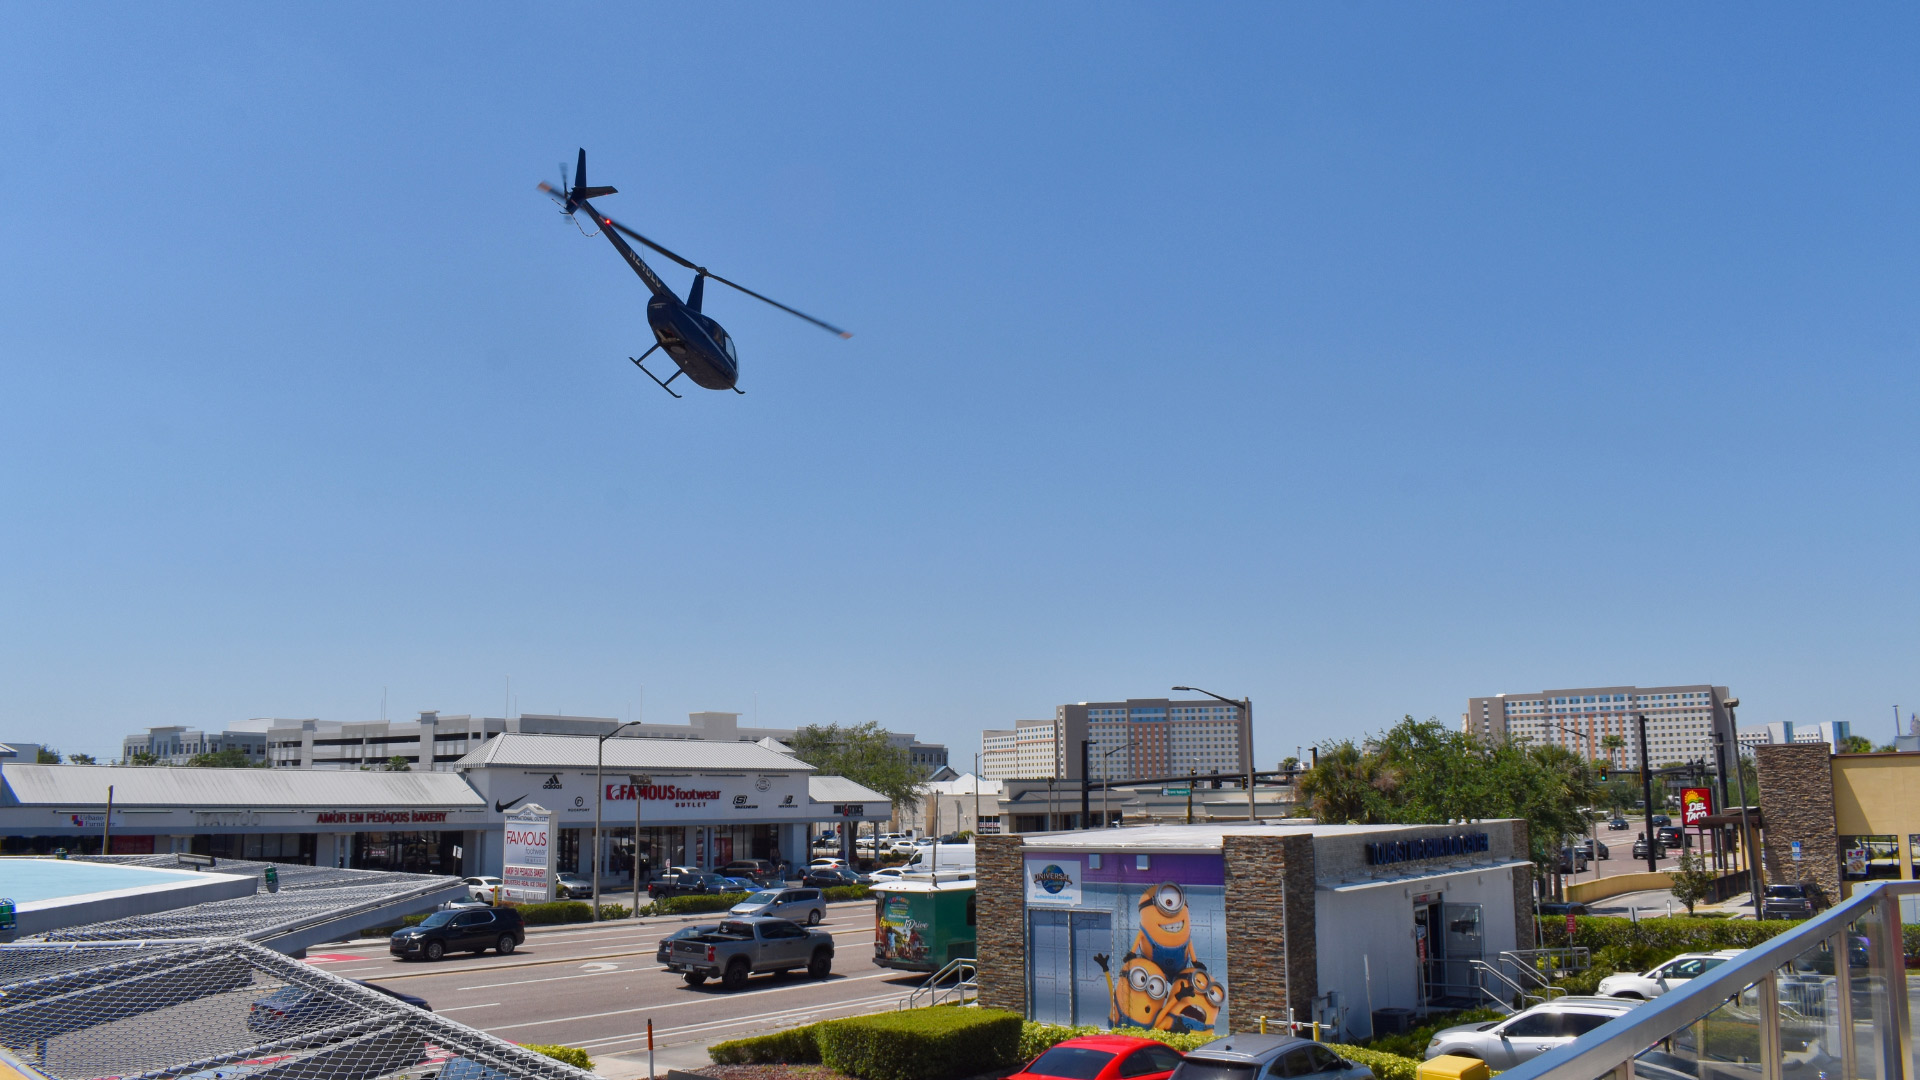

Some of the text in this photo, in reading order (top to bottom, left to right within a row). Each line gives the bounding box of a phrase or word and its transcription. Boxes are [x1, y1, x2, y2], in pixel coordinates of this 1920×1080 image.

[620, 785, 721, 800] FAMOUS footwear
[1688, 802, 1706, 812] DEL
[317, 813, 347, 823] AMOR
[349, 812, 364, 823] EM
[366, 812, 410, 824] PEDAÇOS
[411, 812, 447, 823] BAKERY
[1686, 811, 1707, 823] TACO
[507, 830, 547, 846] FAMOUS
[525, 847, 547, 856] footwear
[1372, 841, 1408, 864] TOURIST
[1462, 833, 1488, 854] CENTER
[1034, 873, 1070, 881] UNIVERSAL
